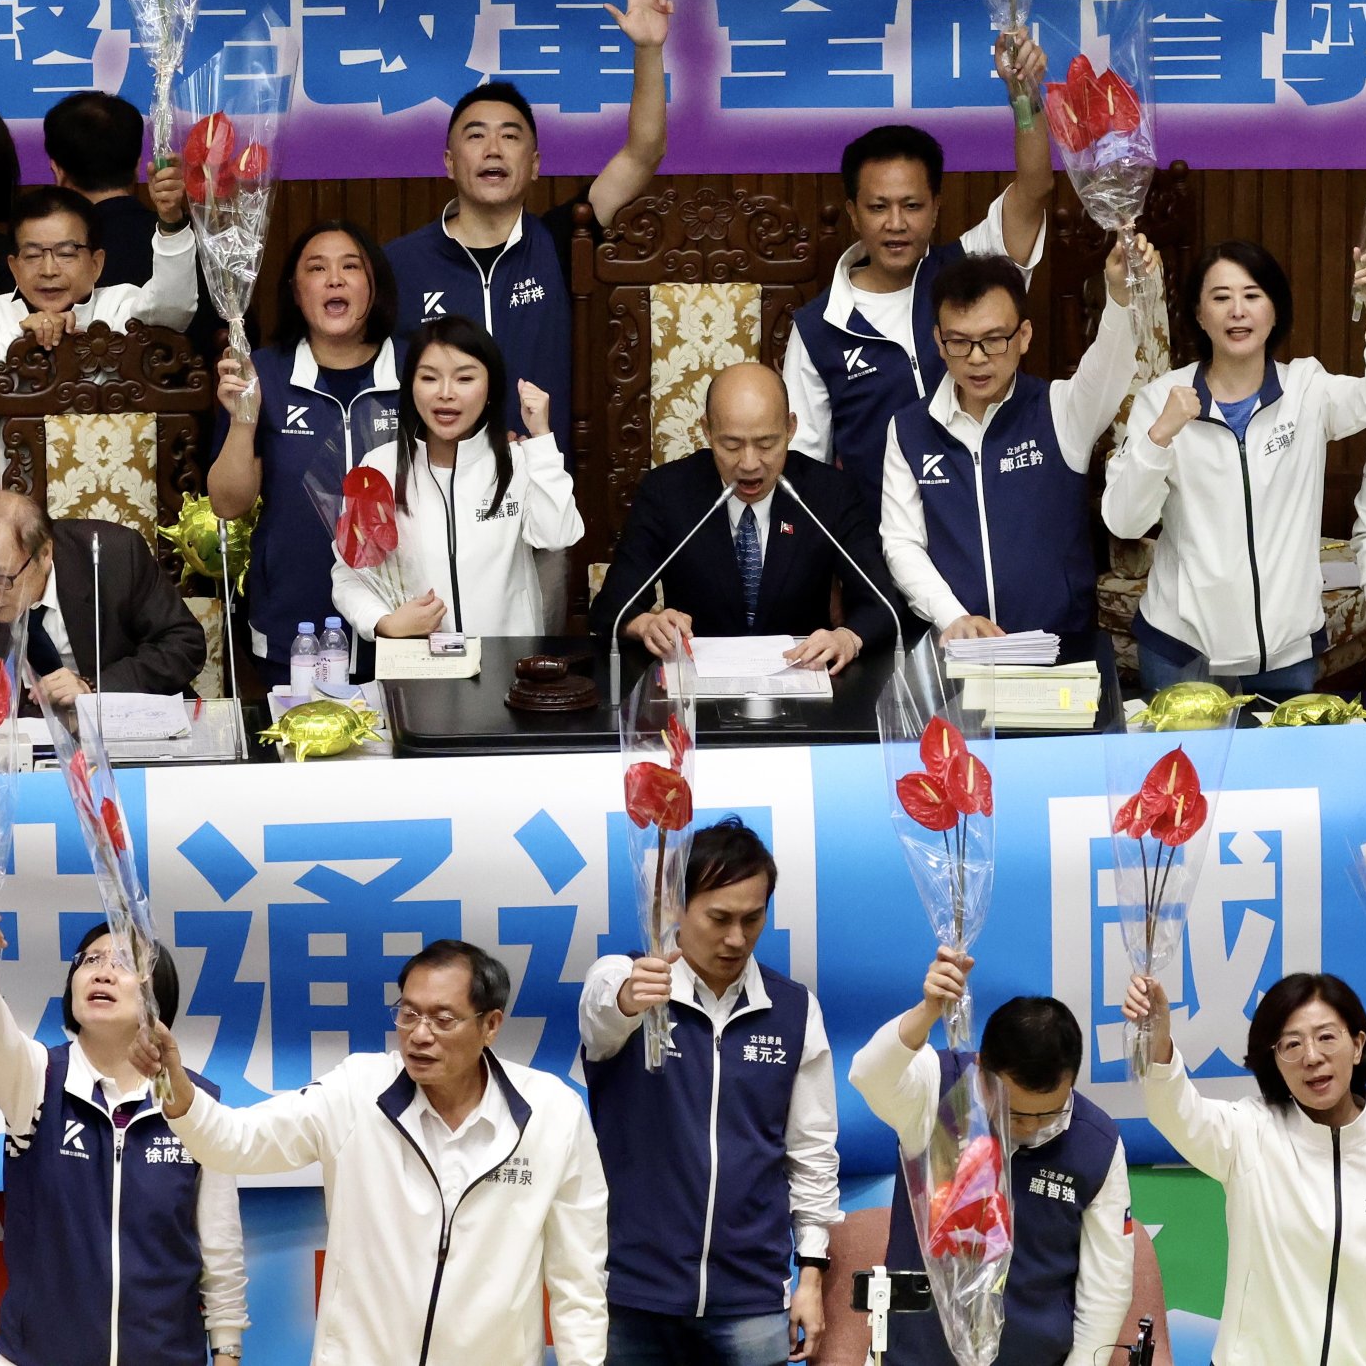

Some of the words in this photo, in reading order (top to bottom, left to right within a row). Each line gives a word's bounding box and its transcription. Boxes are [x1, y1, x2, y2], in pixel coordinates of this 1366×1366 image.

[749, 1034, 783, 1046] 立法委員
[743, 1044, 787, 1065] 葉元之
[145, 1147, 195, 1165] 徐欣瑩
[485, 1168, 532, 1186] 蘇清泉
[1039, 1168, 1074, 1184] 立法委員
[1028, 1177, 1076, 1204] 羅智強
